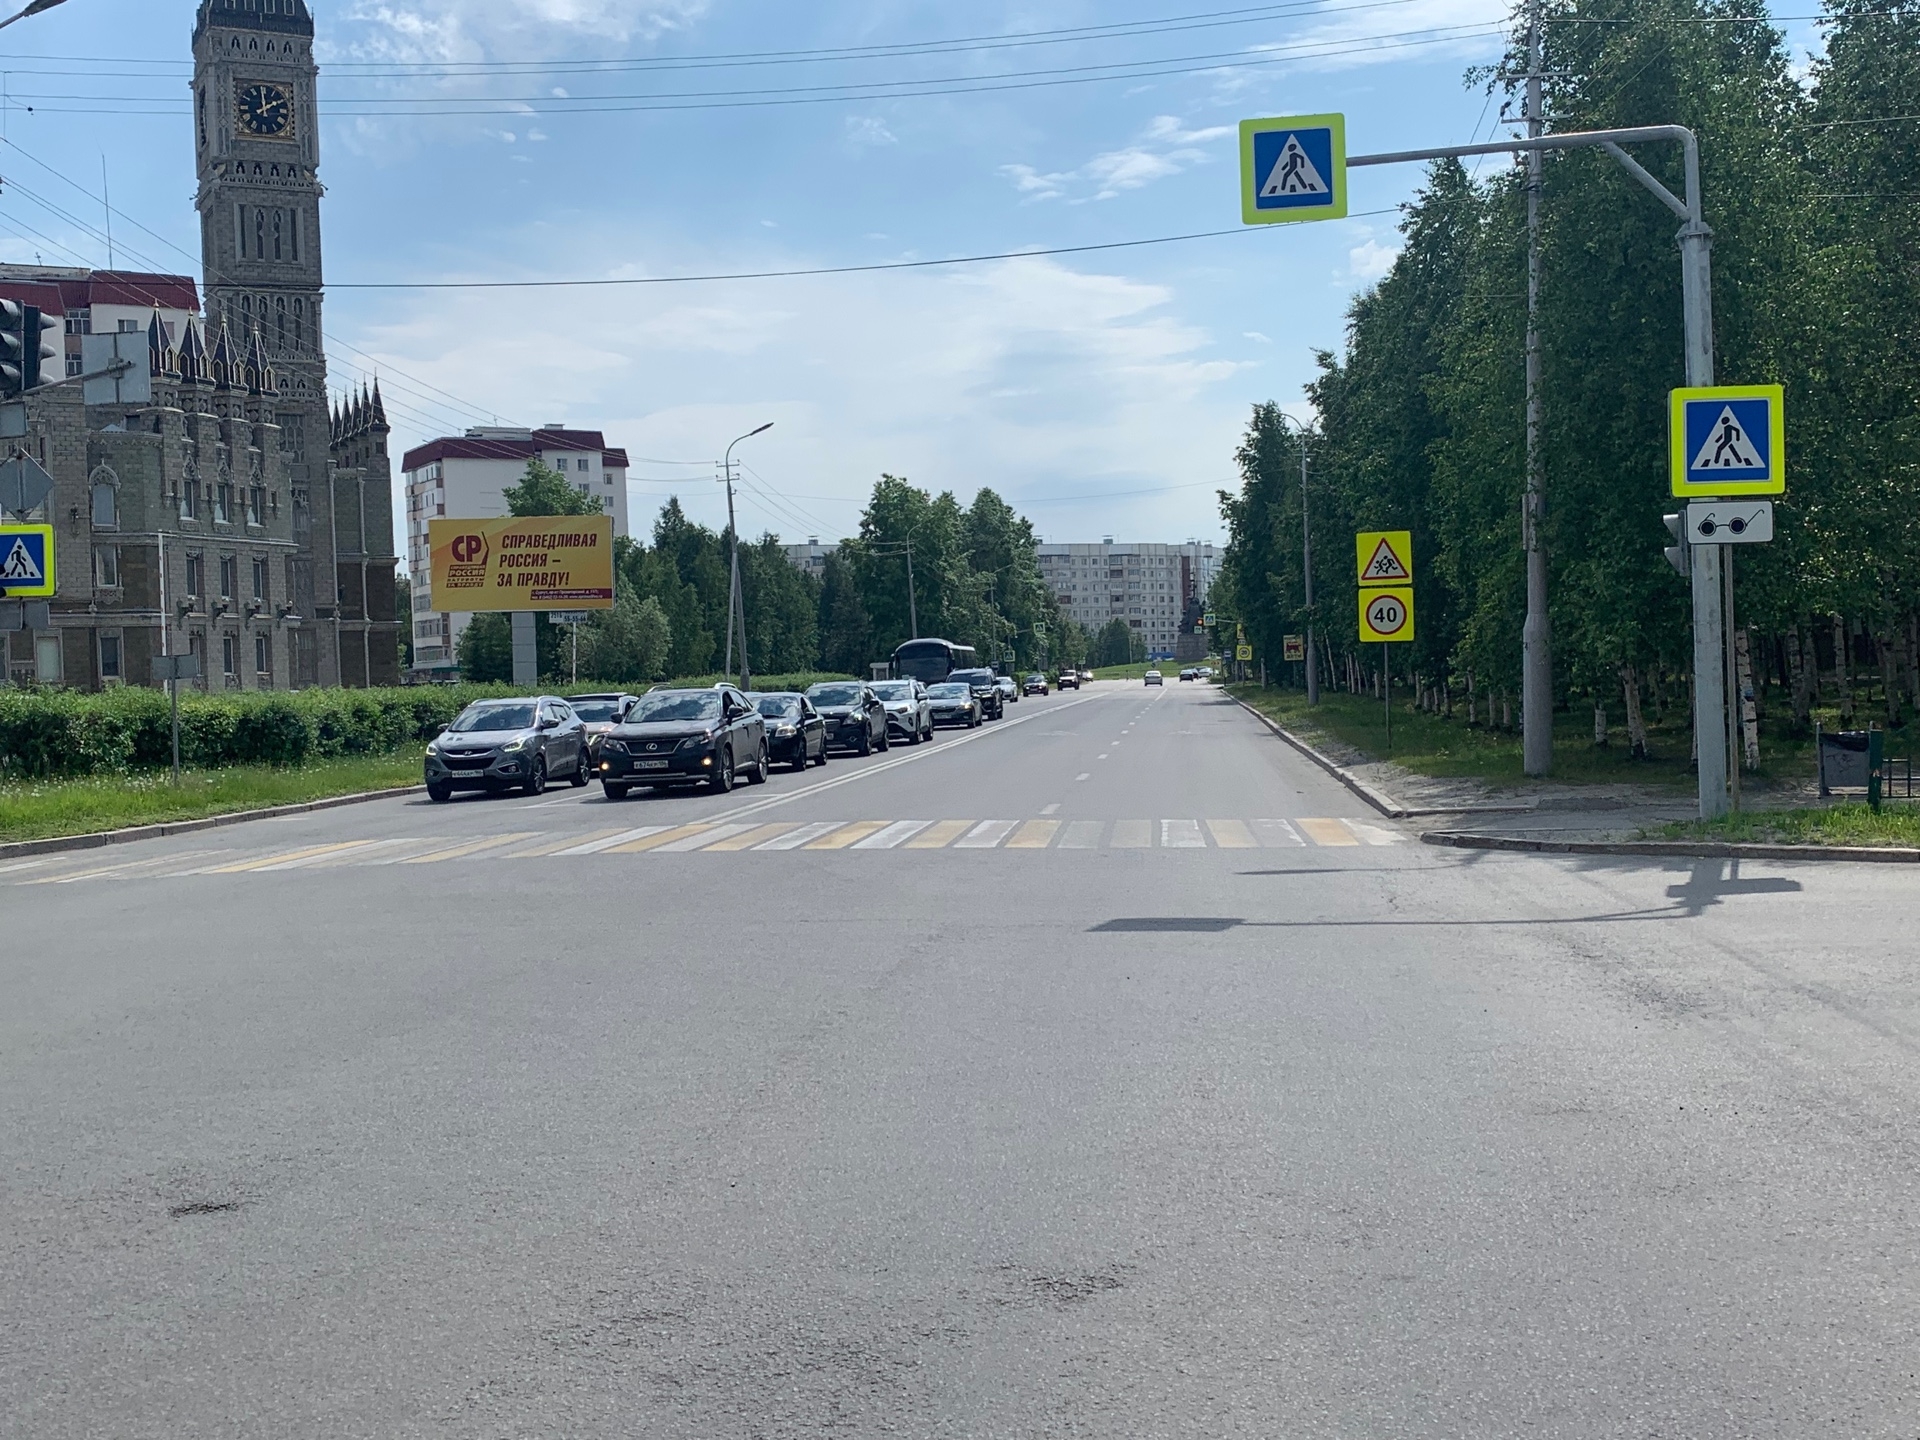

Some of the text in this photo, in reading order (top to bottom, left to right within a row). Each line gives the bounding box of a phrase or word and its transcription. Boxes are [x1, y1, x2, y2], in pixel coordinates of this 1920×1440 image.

[452, 535, 482, 562] СР
[502, 533, 597, 550] СПРАВЕДЛИВАЯ
[499, 553, 548, 568] РОССИЯ
[497, 571, 570, 588] ЗА ПРАВДУ!
[1374, 606, 1397, 623] 40
